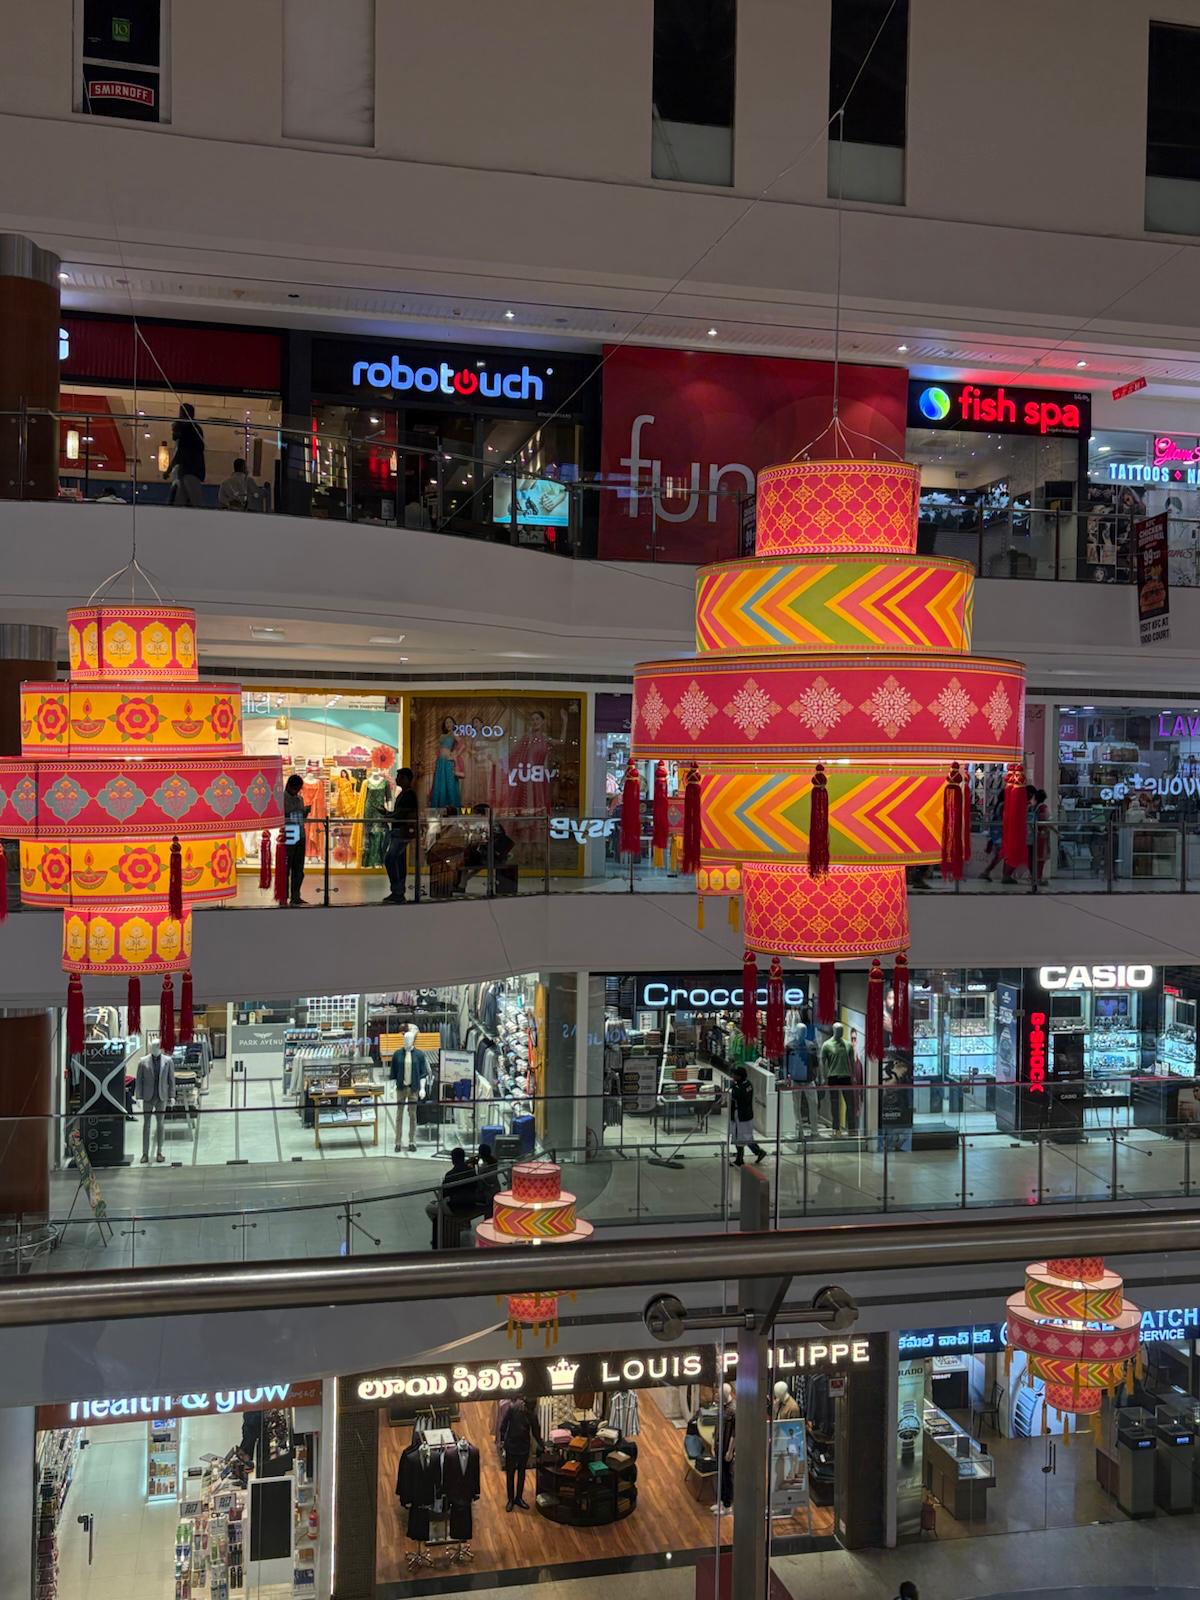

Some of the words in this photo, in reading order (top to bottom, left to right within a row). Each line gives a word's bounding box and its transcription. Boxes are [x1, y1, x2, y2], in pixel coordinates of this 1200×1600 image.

[94, 84, 149, 101] SMIRNOFF
[958, 385, 1017, 423] fish
[1023, 401, 1080, 434] spa
[1109, 463, 1170, 483] TATTOOS
[1039, 964, 1154, 989] CASIO
[239, 1038, 258, 1047] PARK
[259, 1037, 284, 1046] AVENU
[1140, 1307, 1199, 1330] ATCH
[601, 1355, 702, 1383] LOUIS
[723, 1341, 870, 1374] PILIPPE
